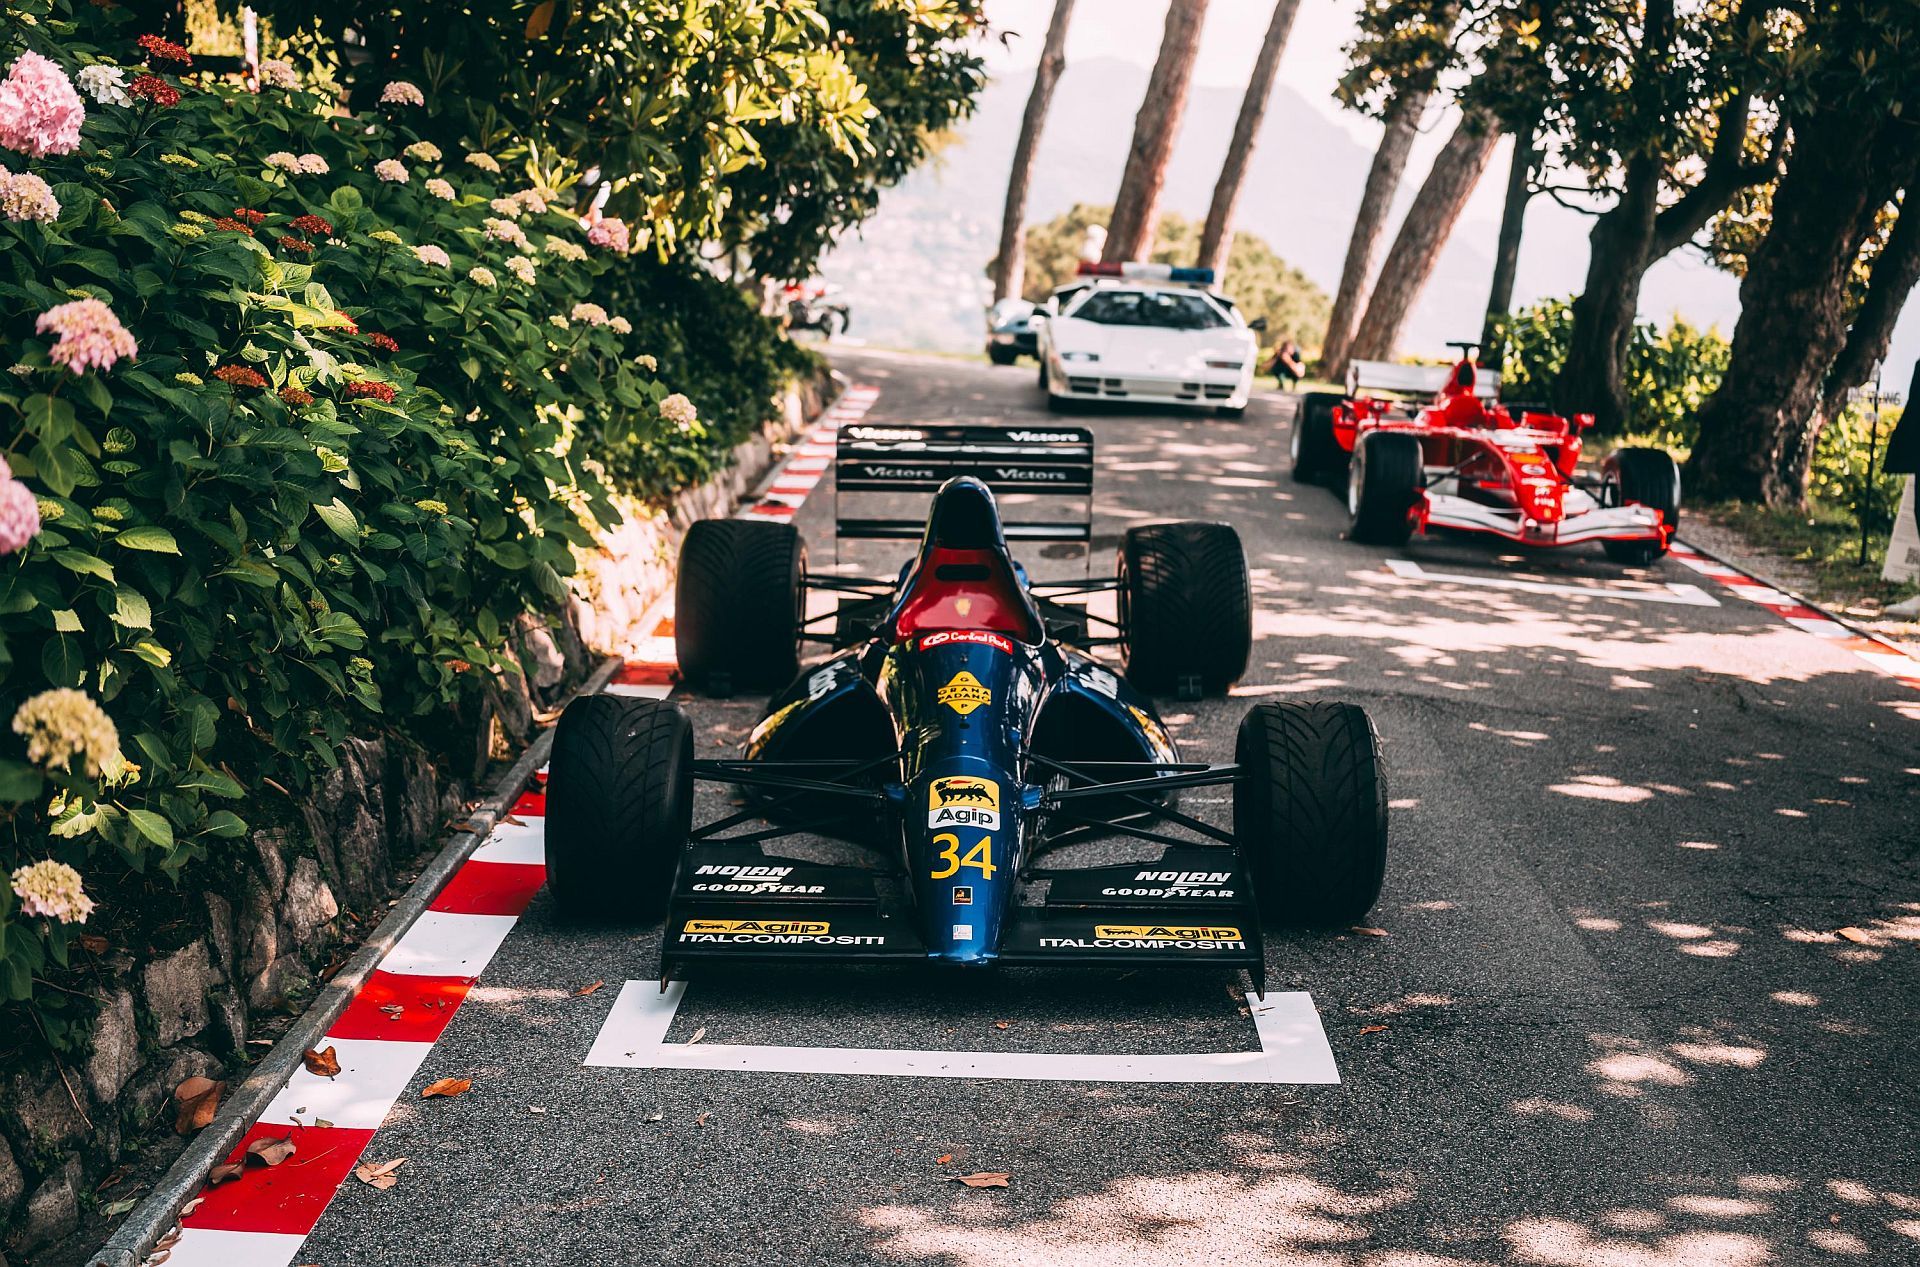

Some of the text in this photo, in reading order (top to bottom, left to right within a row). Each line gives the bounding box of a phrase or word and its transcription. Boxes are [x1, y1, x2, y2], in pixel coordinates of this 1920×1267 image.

[848, 427, 923, 441] Victors
[1006, 431, 1080, 442] Victors
[863, 466, 935, 478] Victors
[995, 468, 1067, 480] Victors
[950, 631, 1010, 650] Central Park
[938, 687, 989, 696] GRANA
[935, 808, 993, 825] Agip
[930, 833, 997, 880] 34
[694, 865, 793, 881] NOLAN
[1134, 871, 1232, 887] NOLAN
[692, 882, 825, 895] GOODYEAR
[1101, 886, 1235, 899] GOODYEAR
[732, 921, 824, 934] Agip
[1144, 927, 1237, 940] Agip
[678, 933, 885, 945] ITALCOMPOSITI
[1039, 938, 1246, 950] ITALCOMPOSITI
